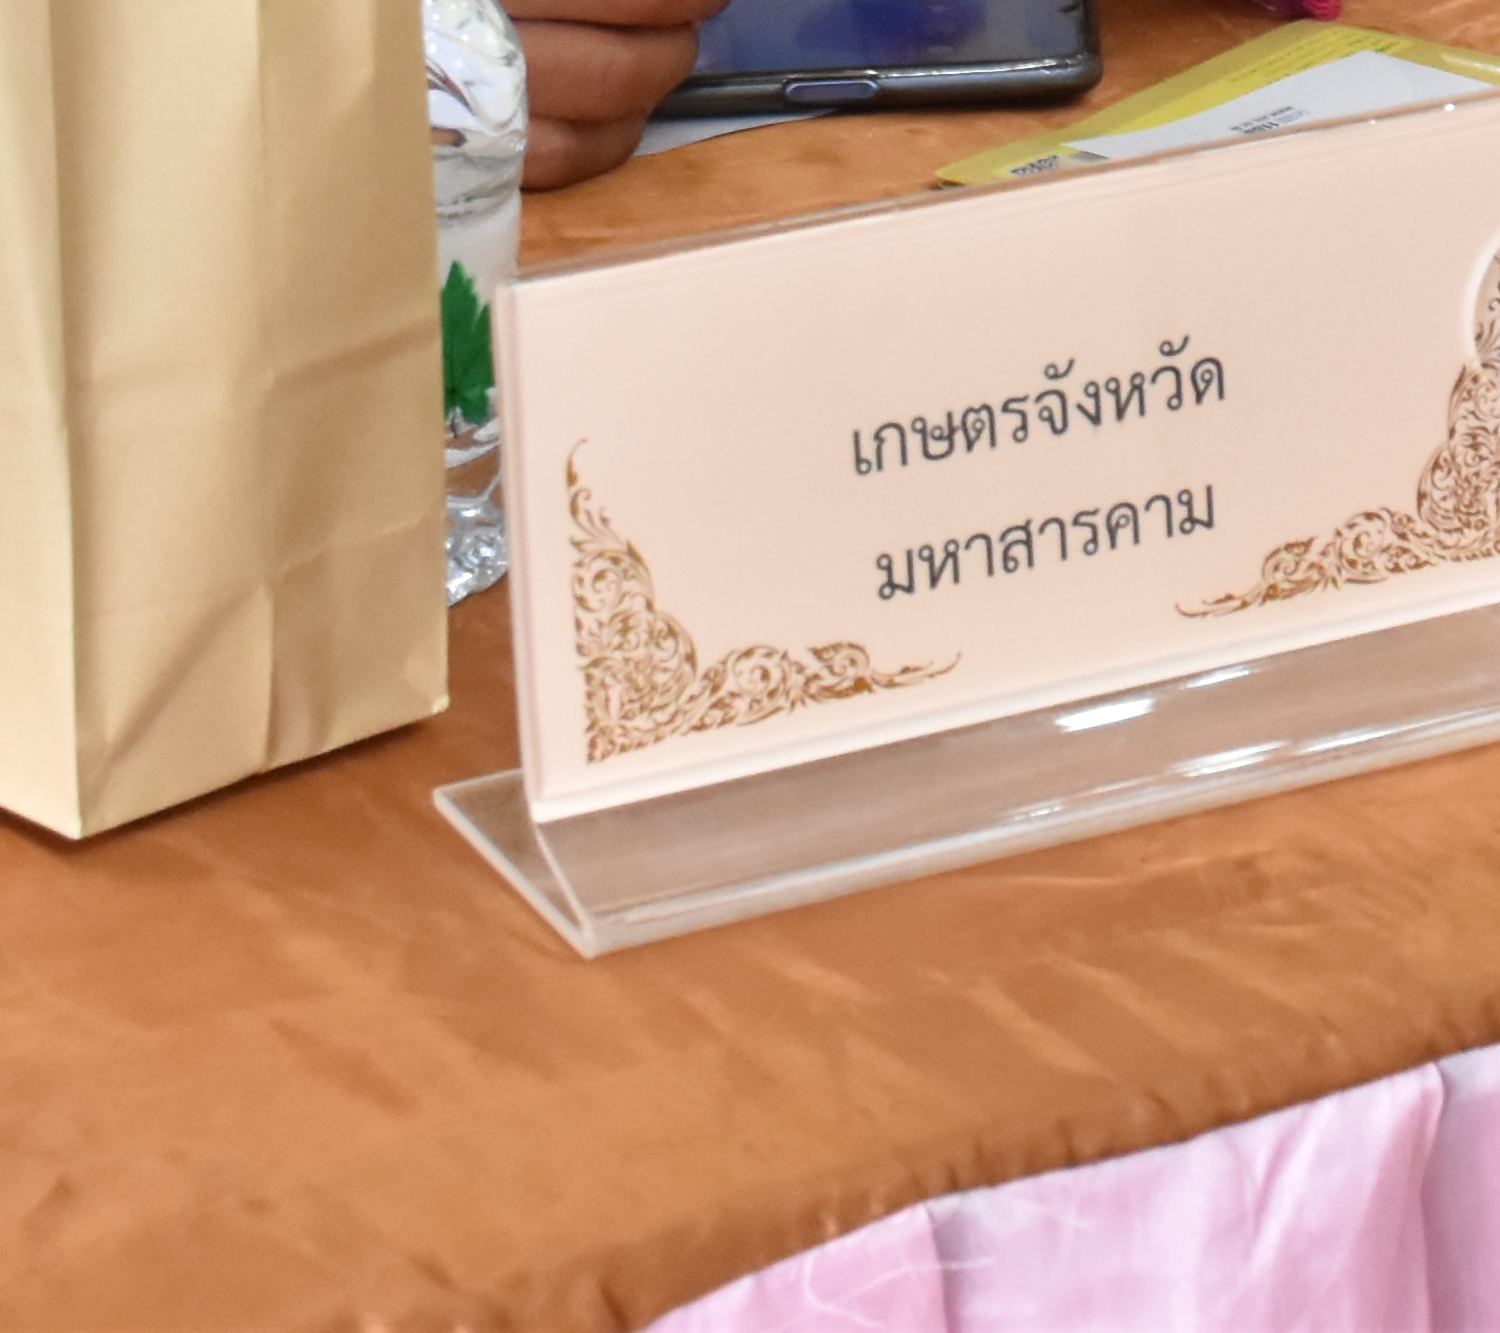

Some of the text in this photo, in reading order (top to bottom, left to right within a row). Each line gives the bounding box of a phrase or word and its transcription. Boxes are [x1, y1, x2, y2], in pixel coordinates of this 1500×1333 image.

[851, 334, 1226, 476] เกษตรจังหวัด
[875, 484, 1216, 601] มหาสารคาม
